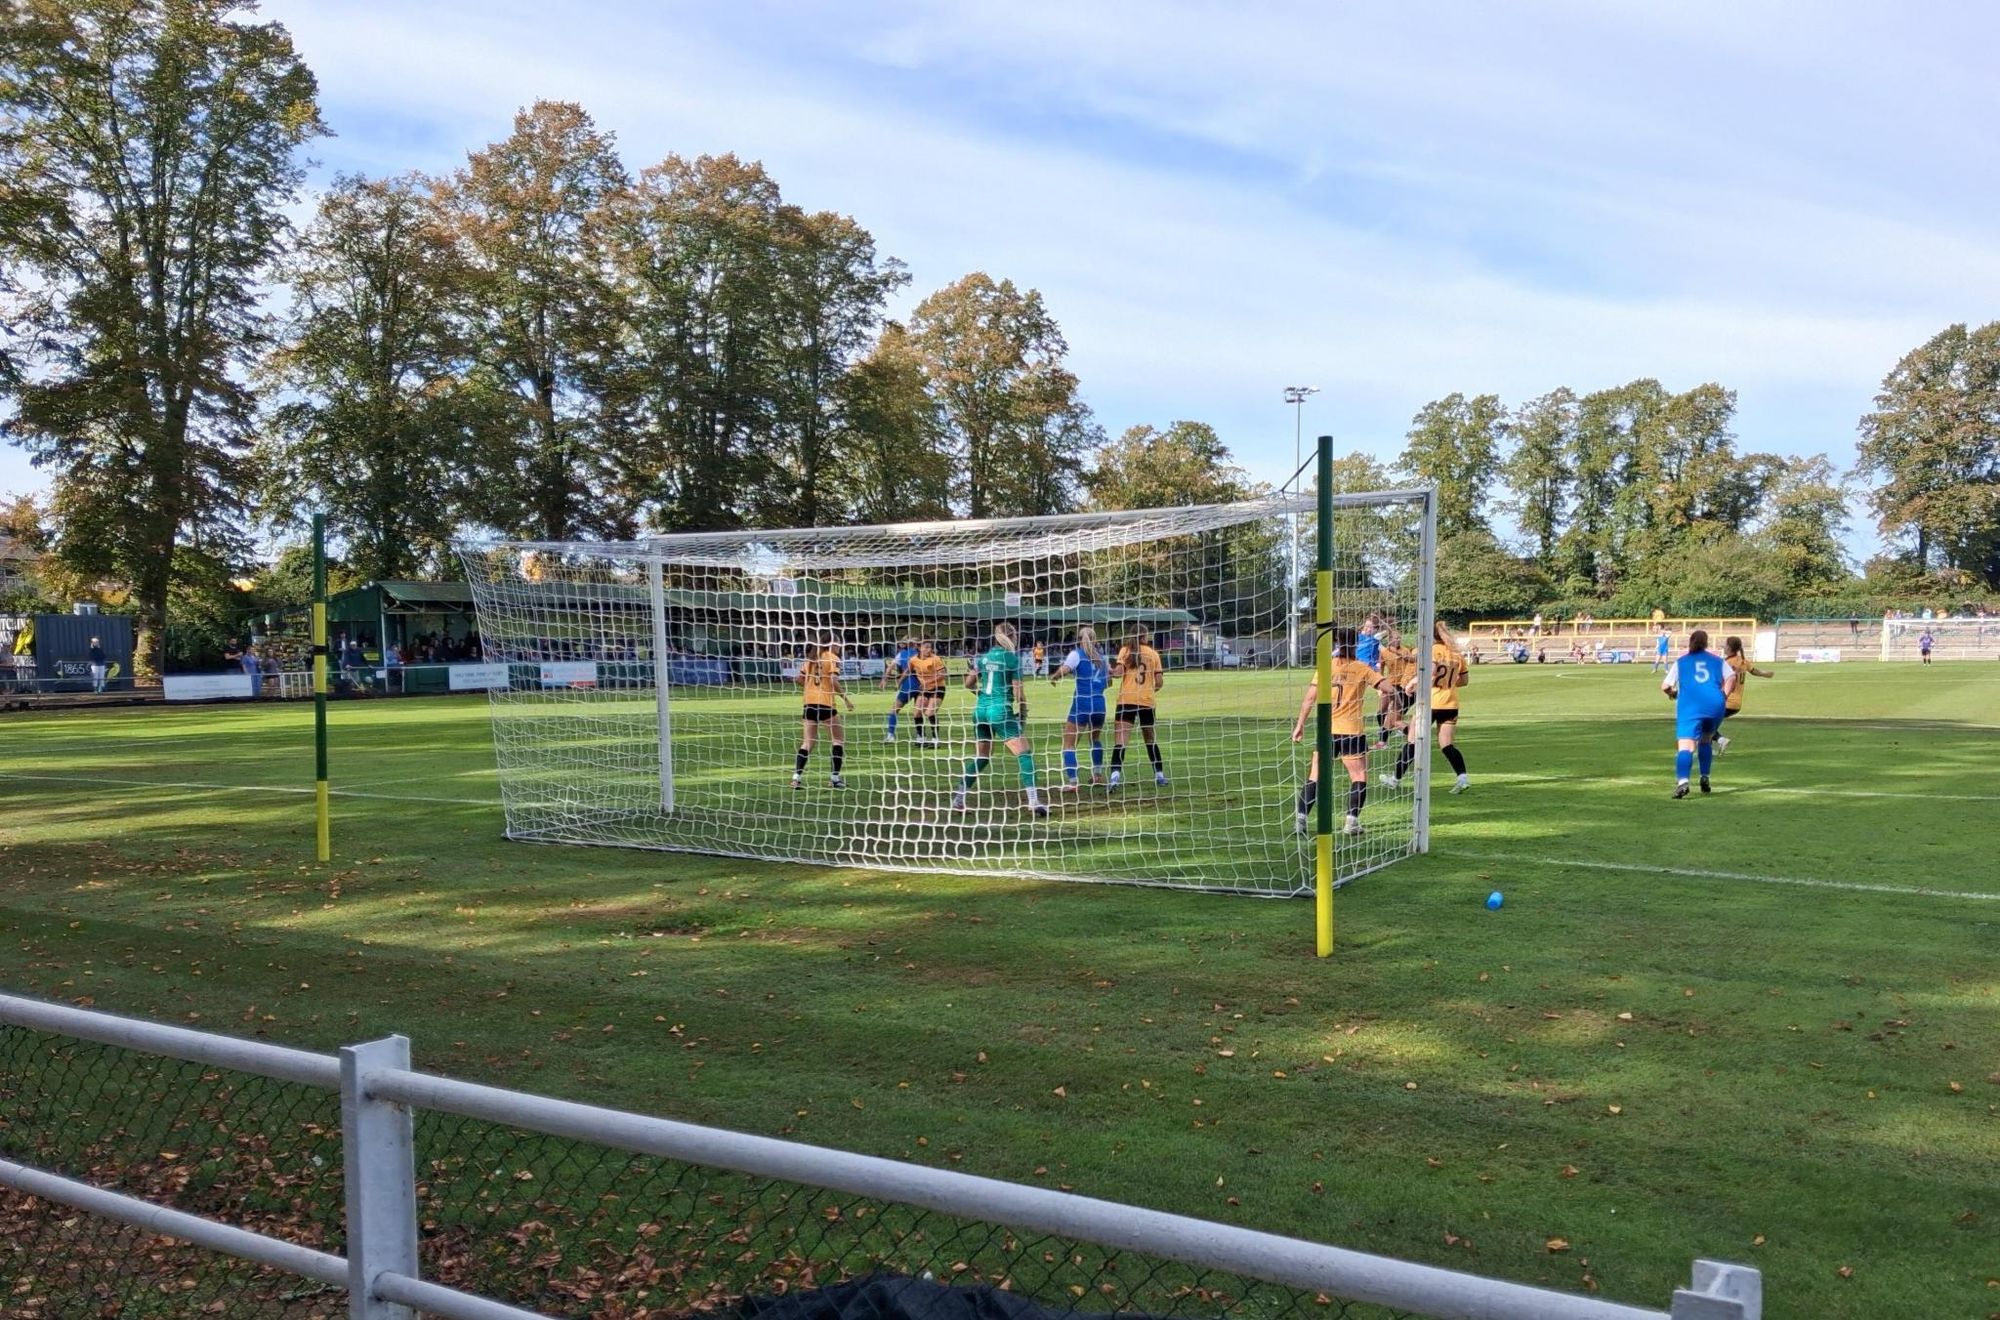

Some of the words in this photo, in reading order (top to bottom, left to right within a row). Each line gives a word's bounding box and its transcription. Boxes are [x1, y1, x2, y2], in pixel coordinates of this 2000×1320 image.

[64, 663, 86, 675] 1865
[1433, 664, 1455, 689] 21
[1694, 661, 1710, 684] 5
